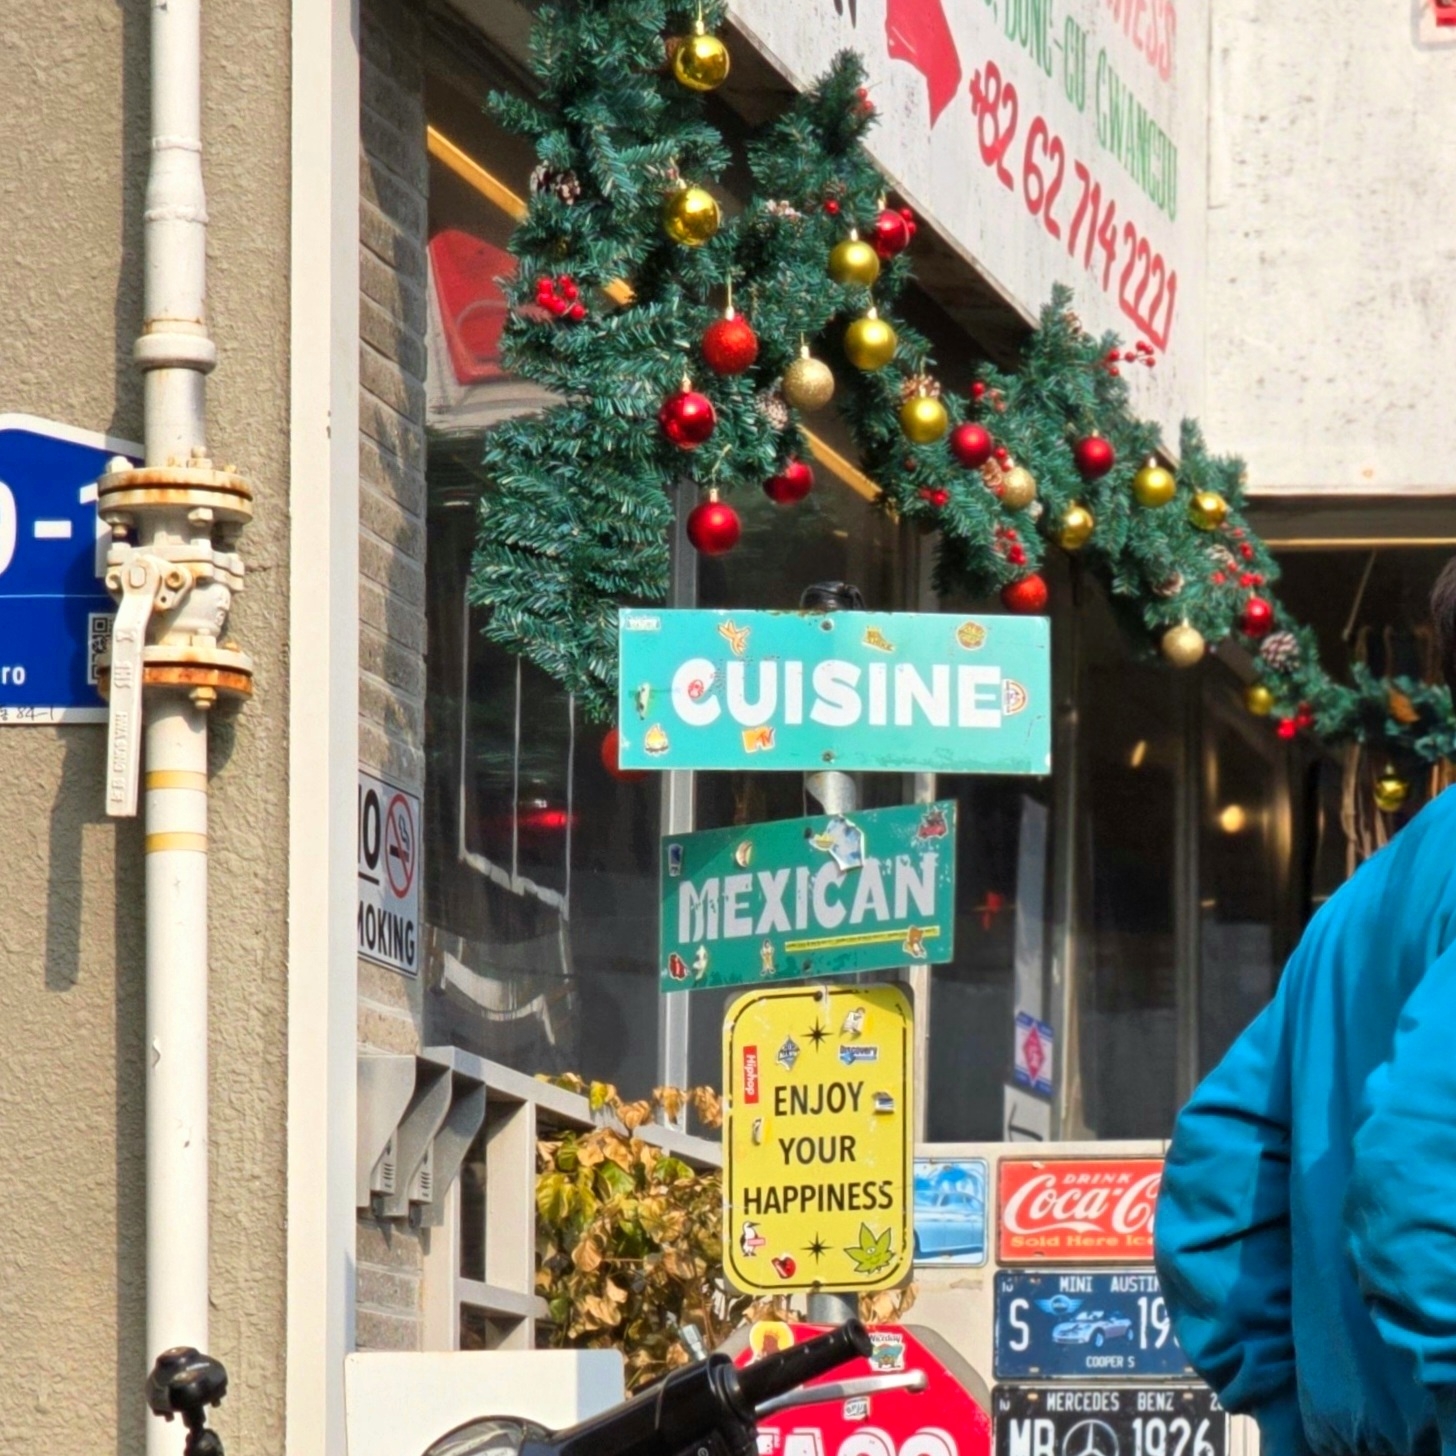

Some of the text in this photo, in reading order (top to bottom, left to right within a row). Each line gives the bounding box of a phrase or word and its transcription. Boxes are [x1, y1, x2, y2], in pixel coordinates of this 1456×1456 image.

[969, 60, 1177, 353] +82 62 714 2221
[671, 657, 1002, 728] CUISINE
[358, 784, 381, 871] O
[678, 852, 939, 944] MEXICAN
[744, 1053, 757, 1097] Hiphop
[774, 1081, 864, 1117] ENJOY
[779, 1135, 856, 1166] YOUR
[1063, 1172, 1133, 1185] DRINK
[743, 1180, 893, 1215] HAPPINESS
[1002, 1172, 1164, 1236] Coca-C
[1010, 1234, 1060, 1249] Sold
[1066, 1234, 1119, 1248] Here
[1060, 1276, 1093, 1293] MINI
[1009, 1296, 1181, 1351] S 19
[1086, 1355, 1136, 1368] COOPER S
[1047, 1391, 1121, 1412] MERCEDES
[1137, 1391, 1174, 1412] BENZ
